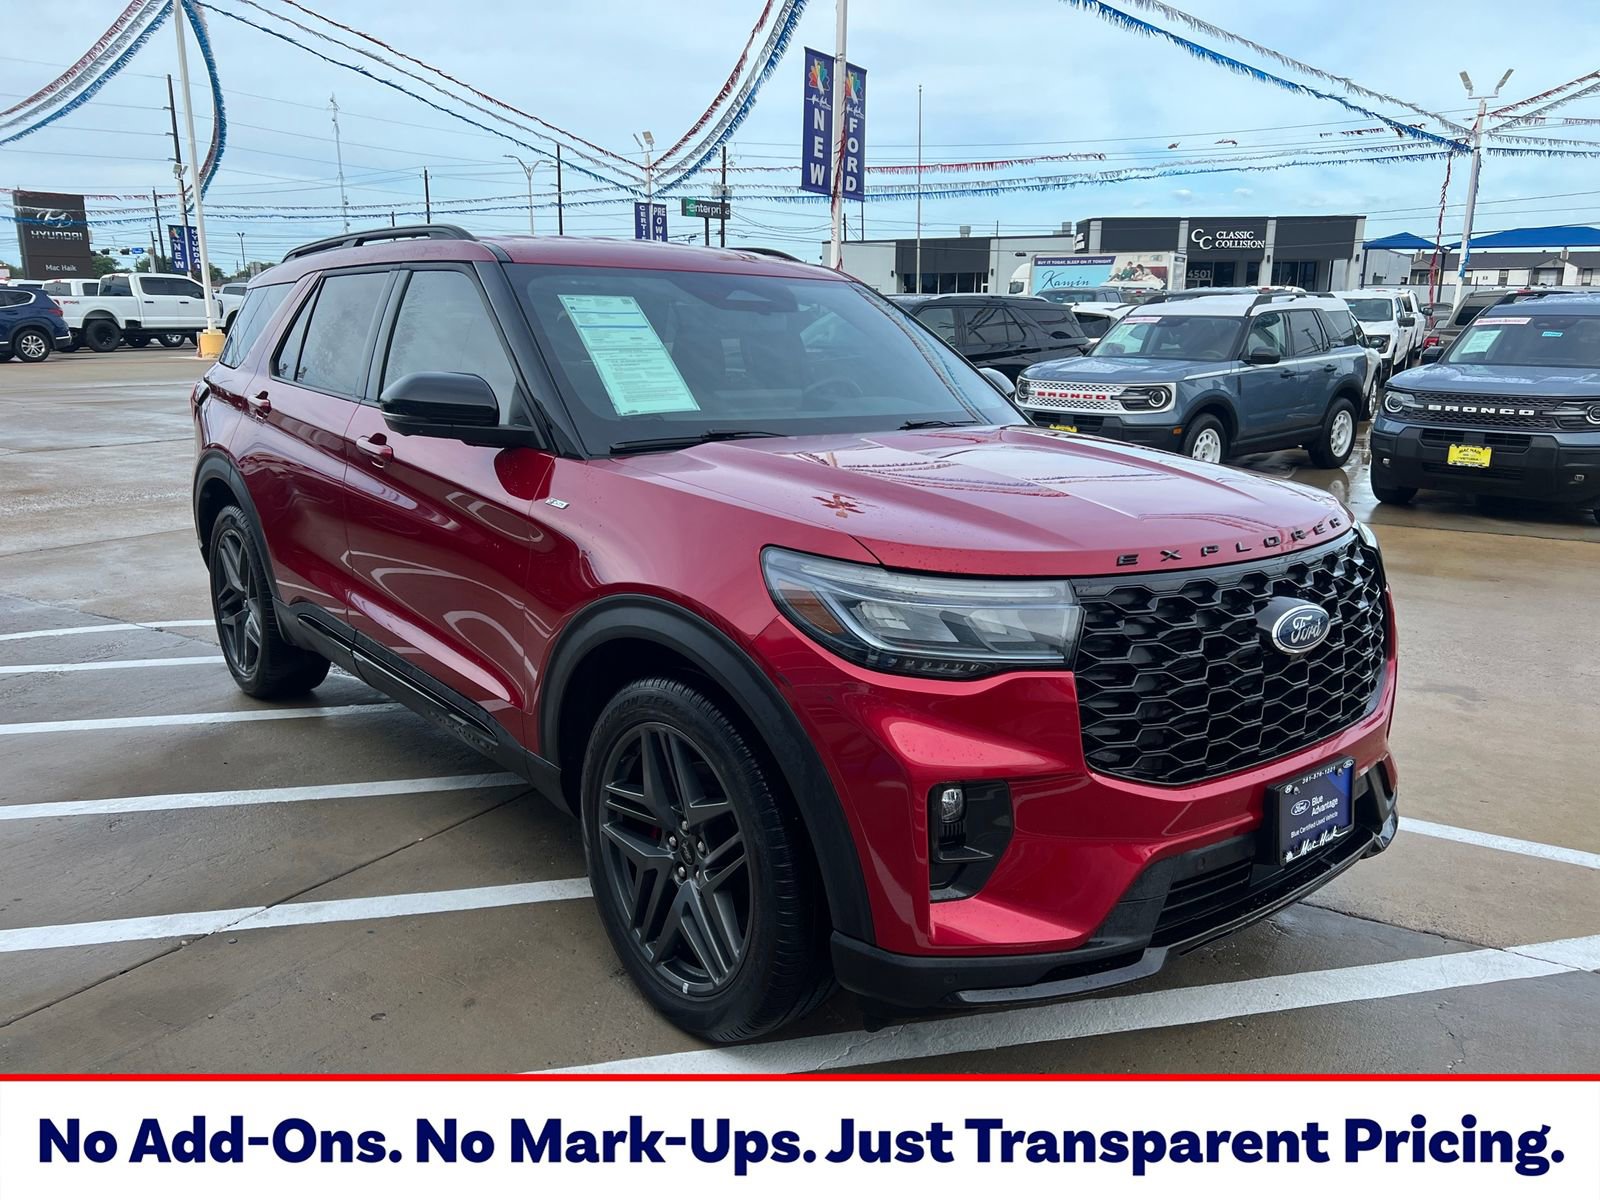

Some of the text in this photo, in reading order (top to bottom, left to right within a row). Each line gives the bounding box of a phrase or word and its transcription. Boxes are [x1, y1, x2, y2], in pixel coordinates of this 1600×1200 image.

[809, 108, 825, 186] NEW
[845, 117, 859, 192] FORD
[653, 207, 666, 216] PRE
[686, 203, 730, 216] enterprie
[1216, 231, 1254, 239] CLASSIC
[1215, 240, 1265, 248] COLLISION
[173, 243, 184, 269] NEW
[61, 264, 77, 272] Haik
[1187, 270, 1211, 278] 4501
[1037, 391, 1107, 400] BRONCO
[1428, 405, 1535, 416] BRONCO
[1116, 517, 1342, 566] EXPLORER
[1290, 614, 1322, 643] Ford
[1311, 795, 1323, 806] Blue
[1311, 798, 1339, 816] Advantage
[1300, 822, 1316, 833] Certified
[1316, 817, 1326, 826] Used
[1326, 811, 1338, 821] Vehicle
